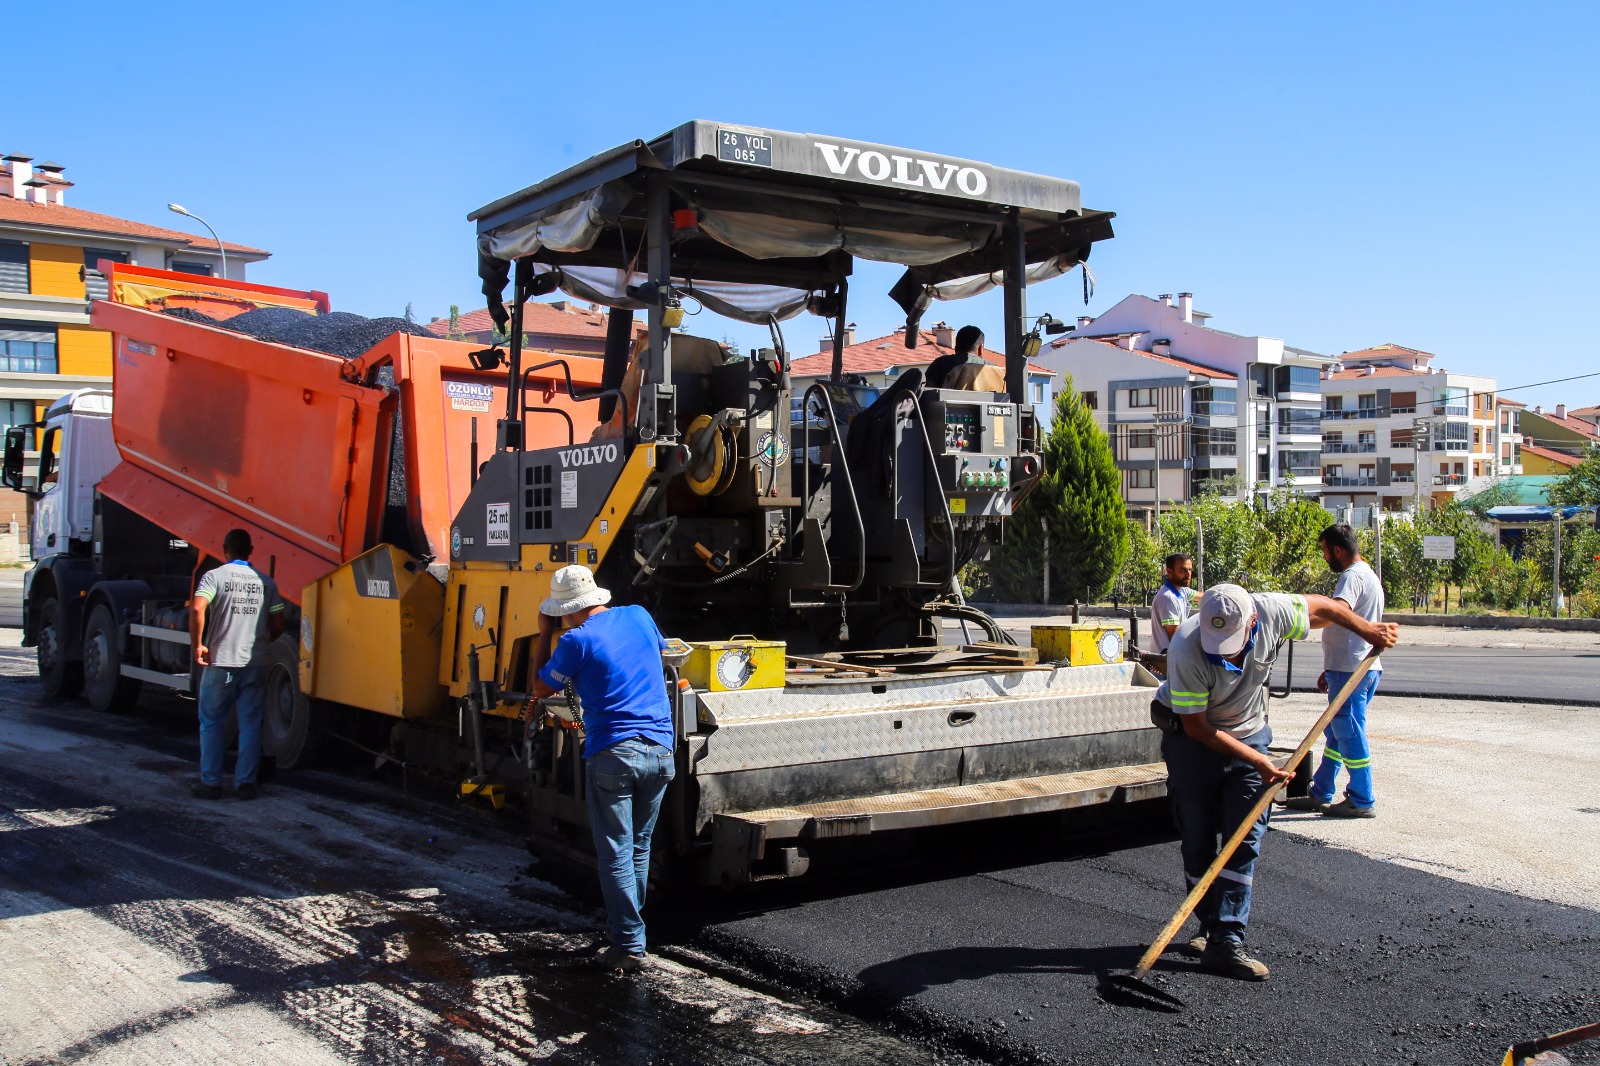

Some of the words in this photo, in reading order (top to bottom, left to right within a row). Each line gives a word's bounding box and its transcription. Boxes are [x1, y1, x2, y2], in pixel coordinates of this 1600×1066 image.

[723, 133, 738, 146] 26
[745, 136, 768, 151] YOL
[734, 148, 756, 162] 065
[814, 142, 988, 196] VOLVO
[448, 381, 491, 396] ÖZÜNLÜ
[453, 398, 486, 408] HARDOX
[558, 443, 618, 468] VOLVO
[489, 509, 498, 524] 25
[500, 511, 508, 524] mt
[488, 530, 508, 542] YAKLAŞMA
[224, 579, 264, 596] BÜYÜKŞEHİ
[231, 606, 240, 614] YOL
